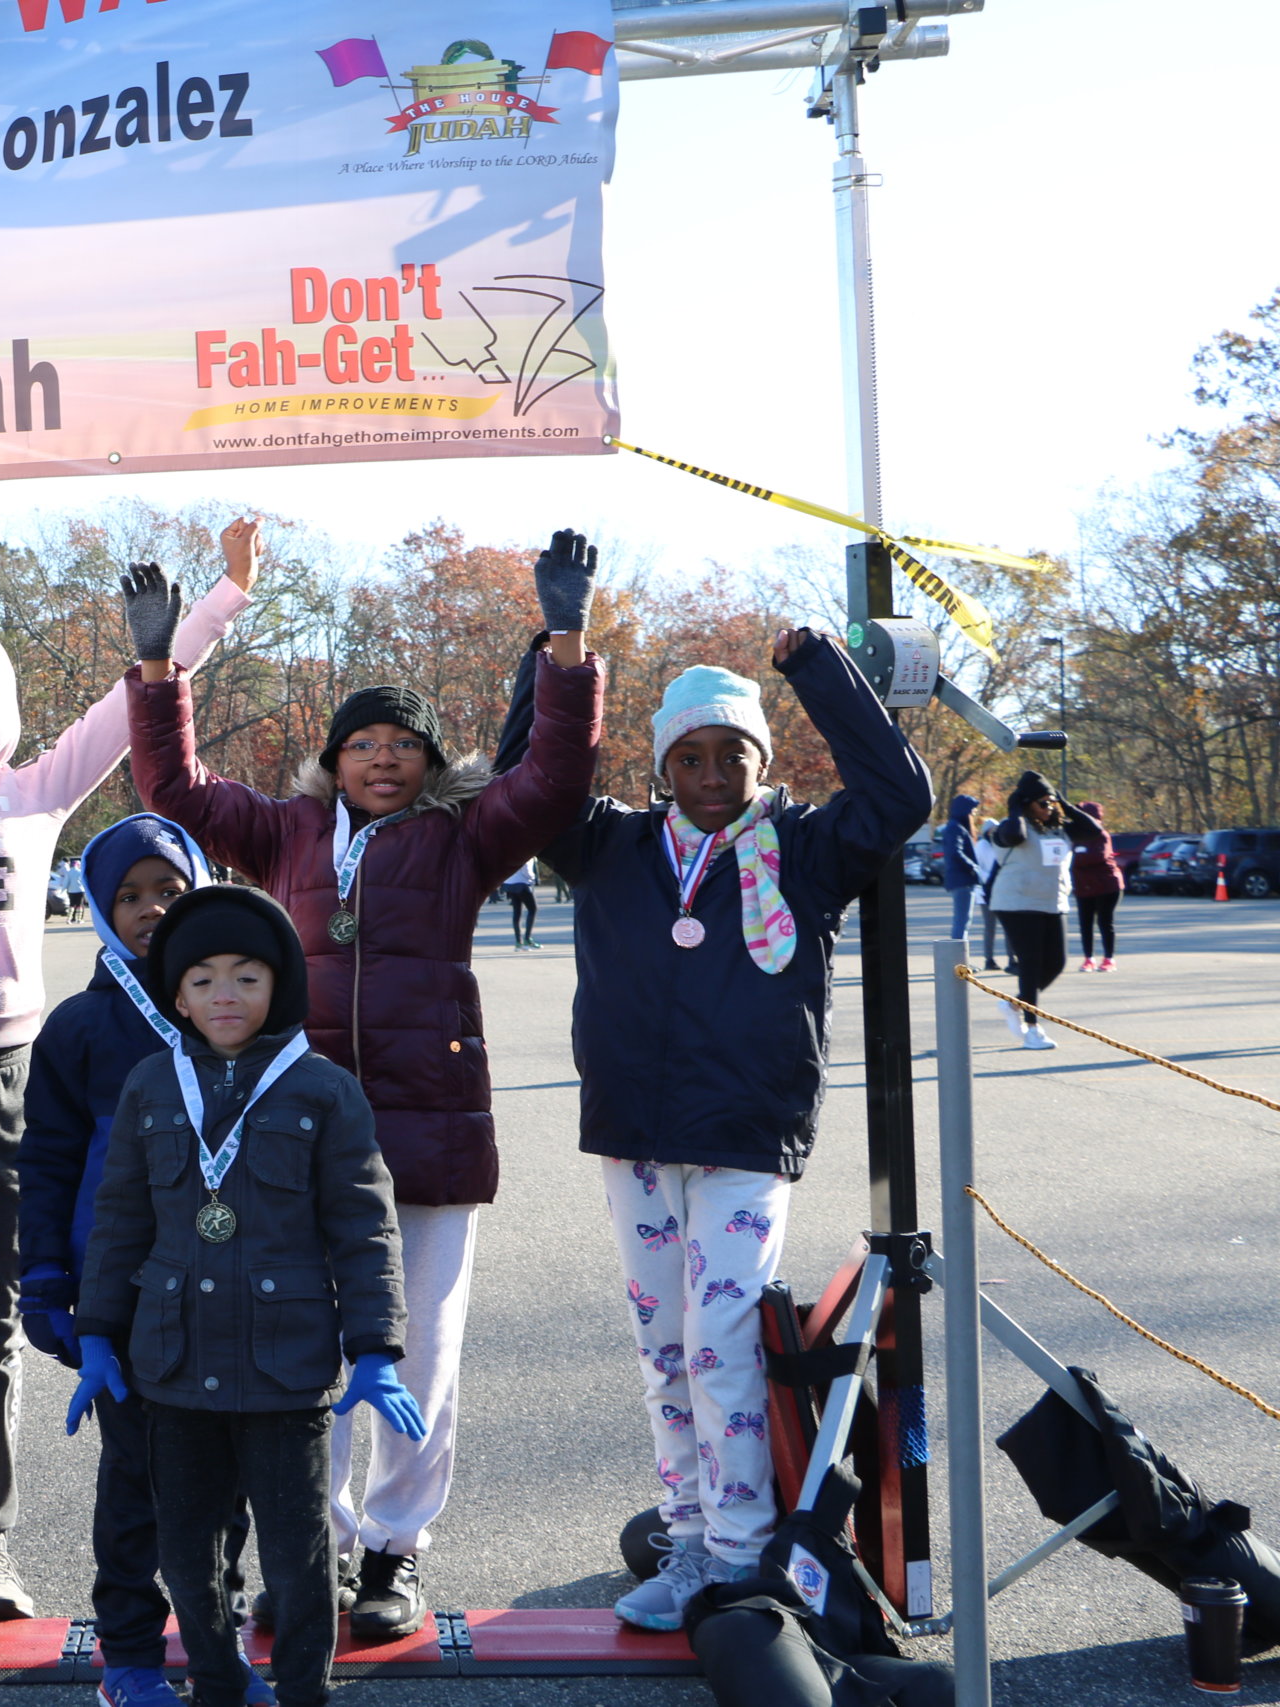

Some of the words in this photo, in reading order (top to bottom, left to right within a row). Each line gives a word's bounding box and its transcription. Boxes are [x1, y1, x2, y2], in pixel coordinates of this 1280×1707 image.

[405, 98, 444, 118] THE
[460, 93, 530, 109] HOUSE
[403, 116, 531, 157] JUDAH
[338, 163, 351, 175] A
[352, 162, 384, 174] Place
[387, 160, 425, 172] Where
[427, 157, 478, 171] Worship
[480, 157, 493, 167] to
[495, 155, 513, 167] the
[516, 154, 556, 166] LORD
[558, 152, 599, 165] Abides
[290, 263, 443, 325] Don't
[234, 399, 290, 415] HOME
[301, 397, 460, 412] IMPROVEMENTS
[213, 425, 579, 450] www.dontfahgethomeimprovements.com
[680, 921, 694, 938] 3
